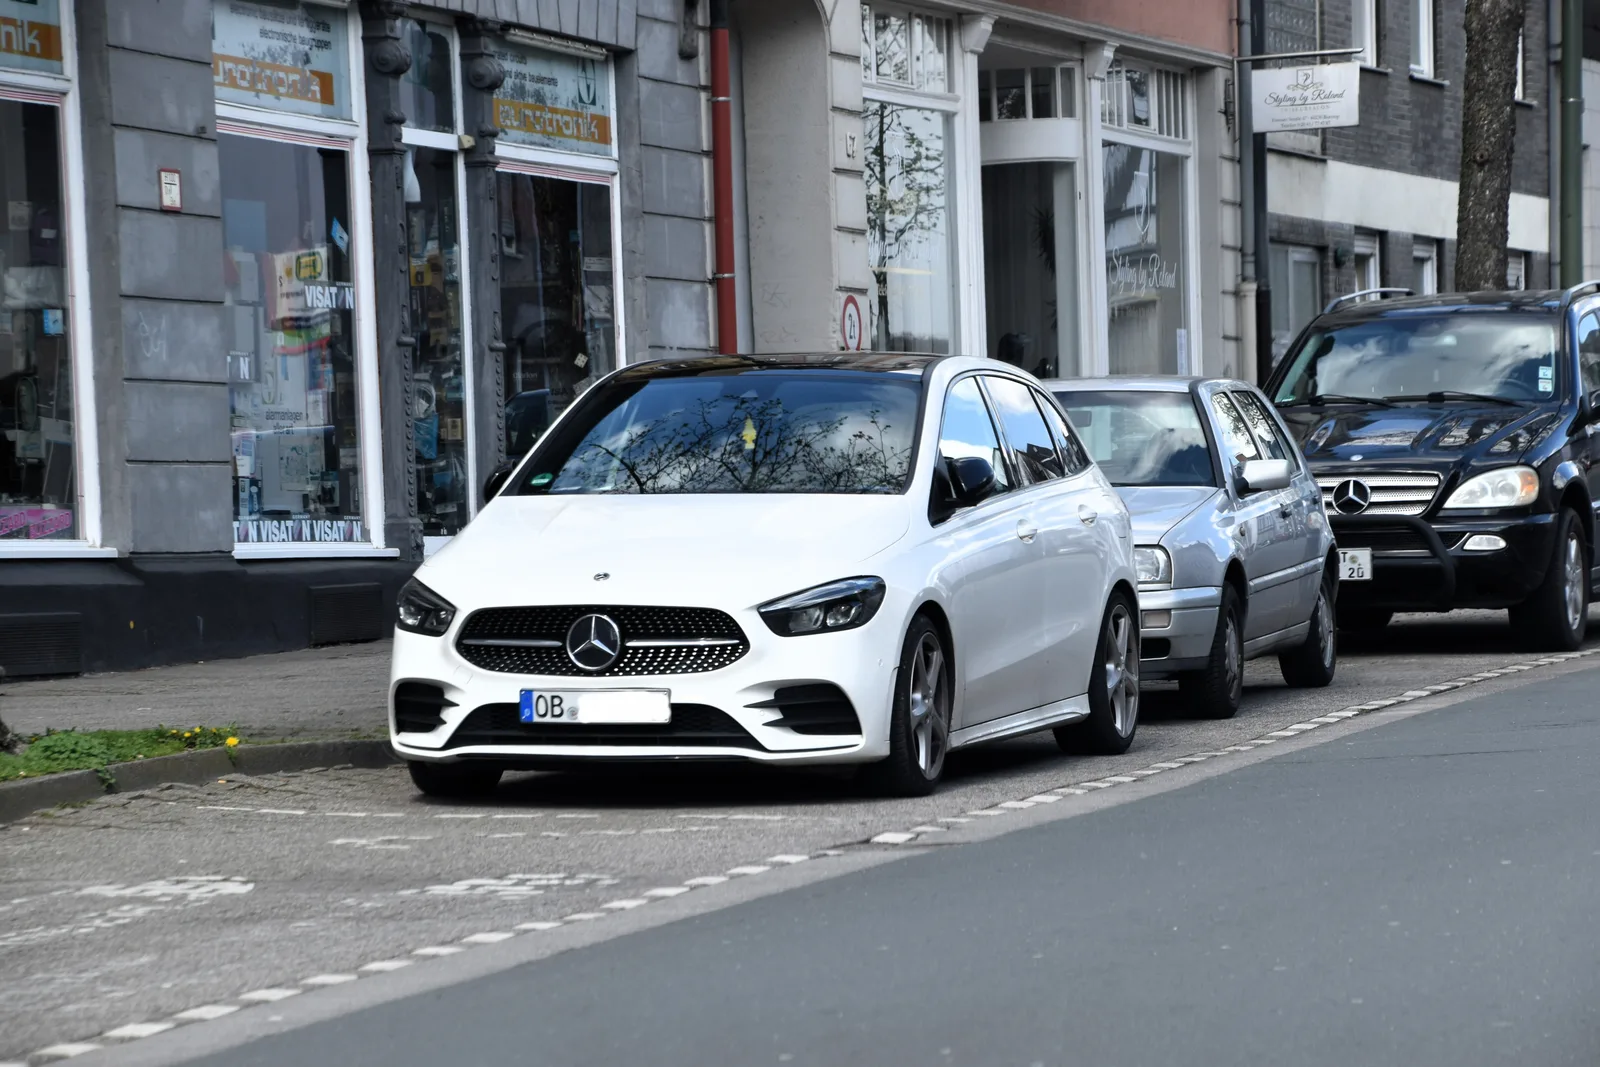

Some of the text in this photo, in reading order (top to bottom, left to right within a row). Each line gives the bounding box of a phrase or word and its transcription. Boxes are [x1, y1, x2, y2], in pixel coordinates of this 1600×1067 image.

[1264, 88, 1346, 107] Styling by Roland
[499, 105, 599, 140] eurotronik
[1109, 247, 1177, 298] Styling by Roland
[265, 408, 303, 425] alarmanlagen
[1341, 551, 1348, 563] T
[535, 694, 564, 718] OB
